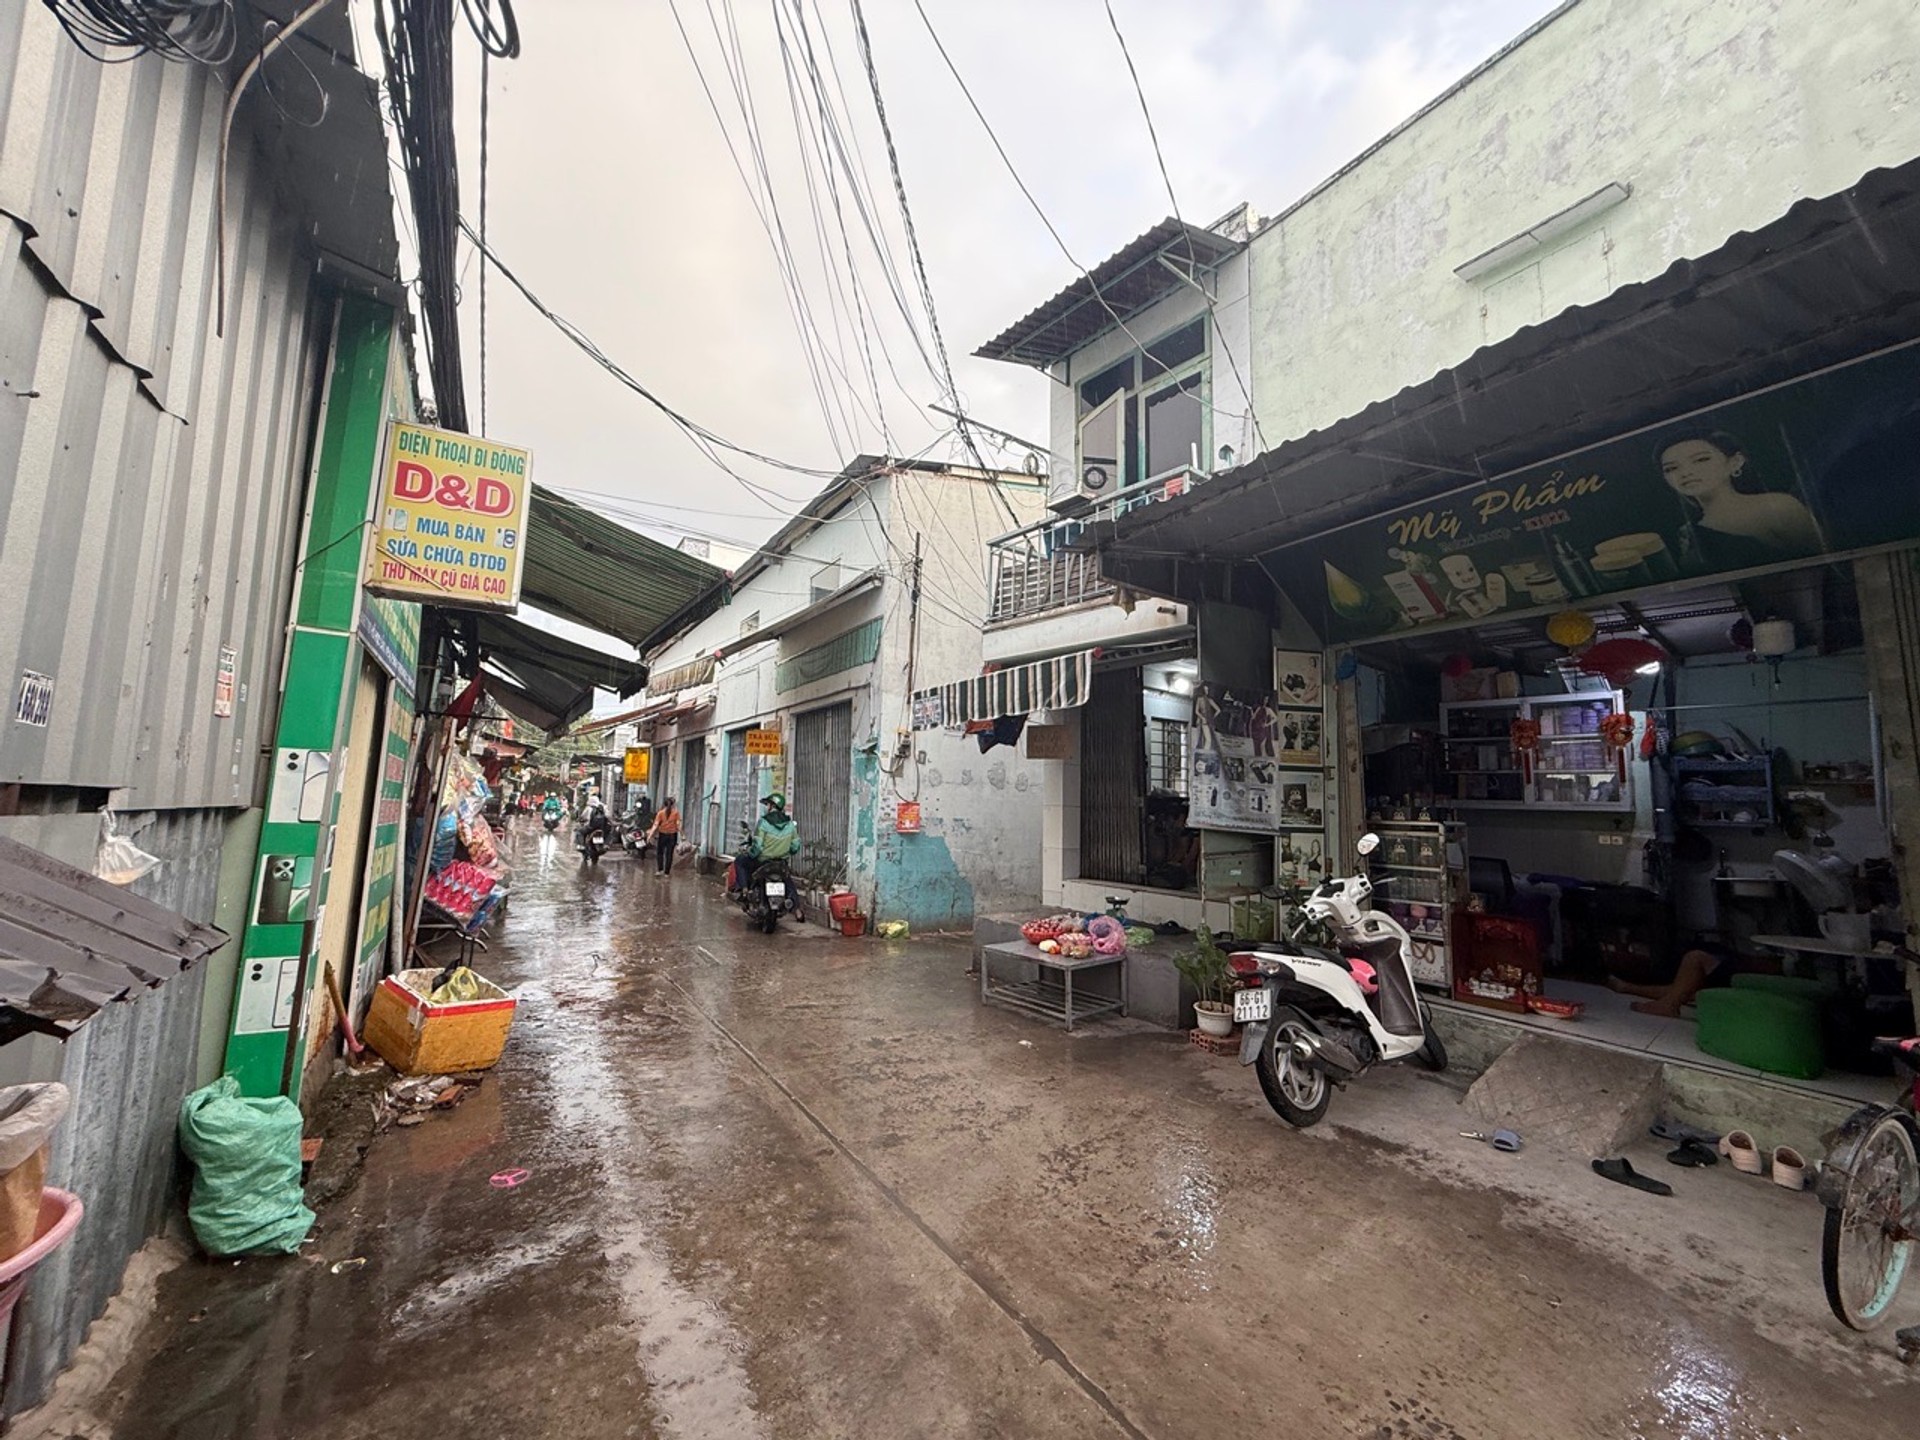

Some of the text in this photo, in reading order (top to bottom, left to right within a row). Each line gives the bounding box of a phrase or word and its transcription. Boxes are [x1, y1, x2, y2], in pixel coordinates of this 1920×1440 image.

[399, 431, 525, 476] ĐIỆN THOẠI ĐI ĐỘNG
[392, 459, 514, 516] D&D
[1387, 509, 1463, 546] Mỹ
[1472, 470, 1606, 525] Phẩm
[416, 517, 486, 543] MUA BÁN
[386, 535, 418, 559] SỬA
[423, 545, 464, 566] CHỮA
[382, 561, 406, 580] THU
[440, 568, 457, 587] CŨ
[460, 571, 480, 590] GIÁ
[483, 577, 506, 594] CAO
